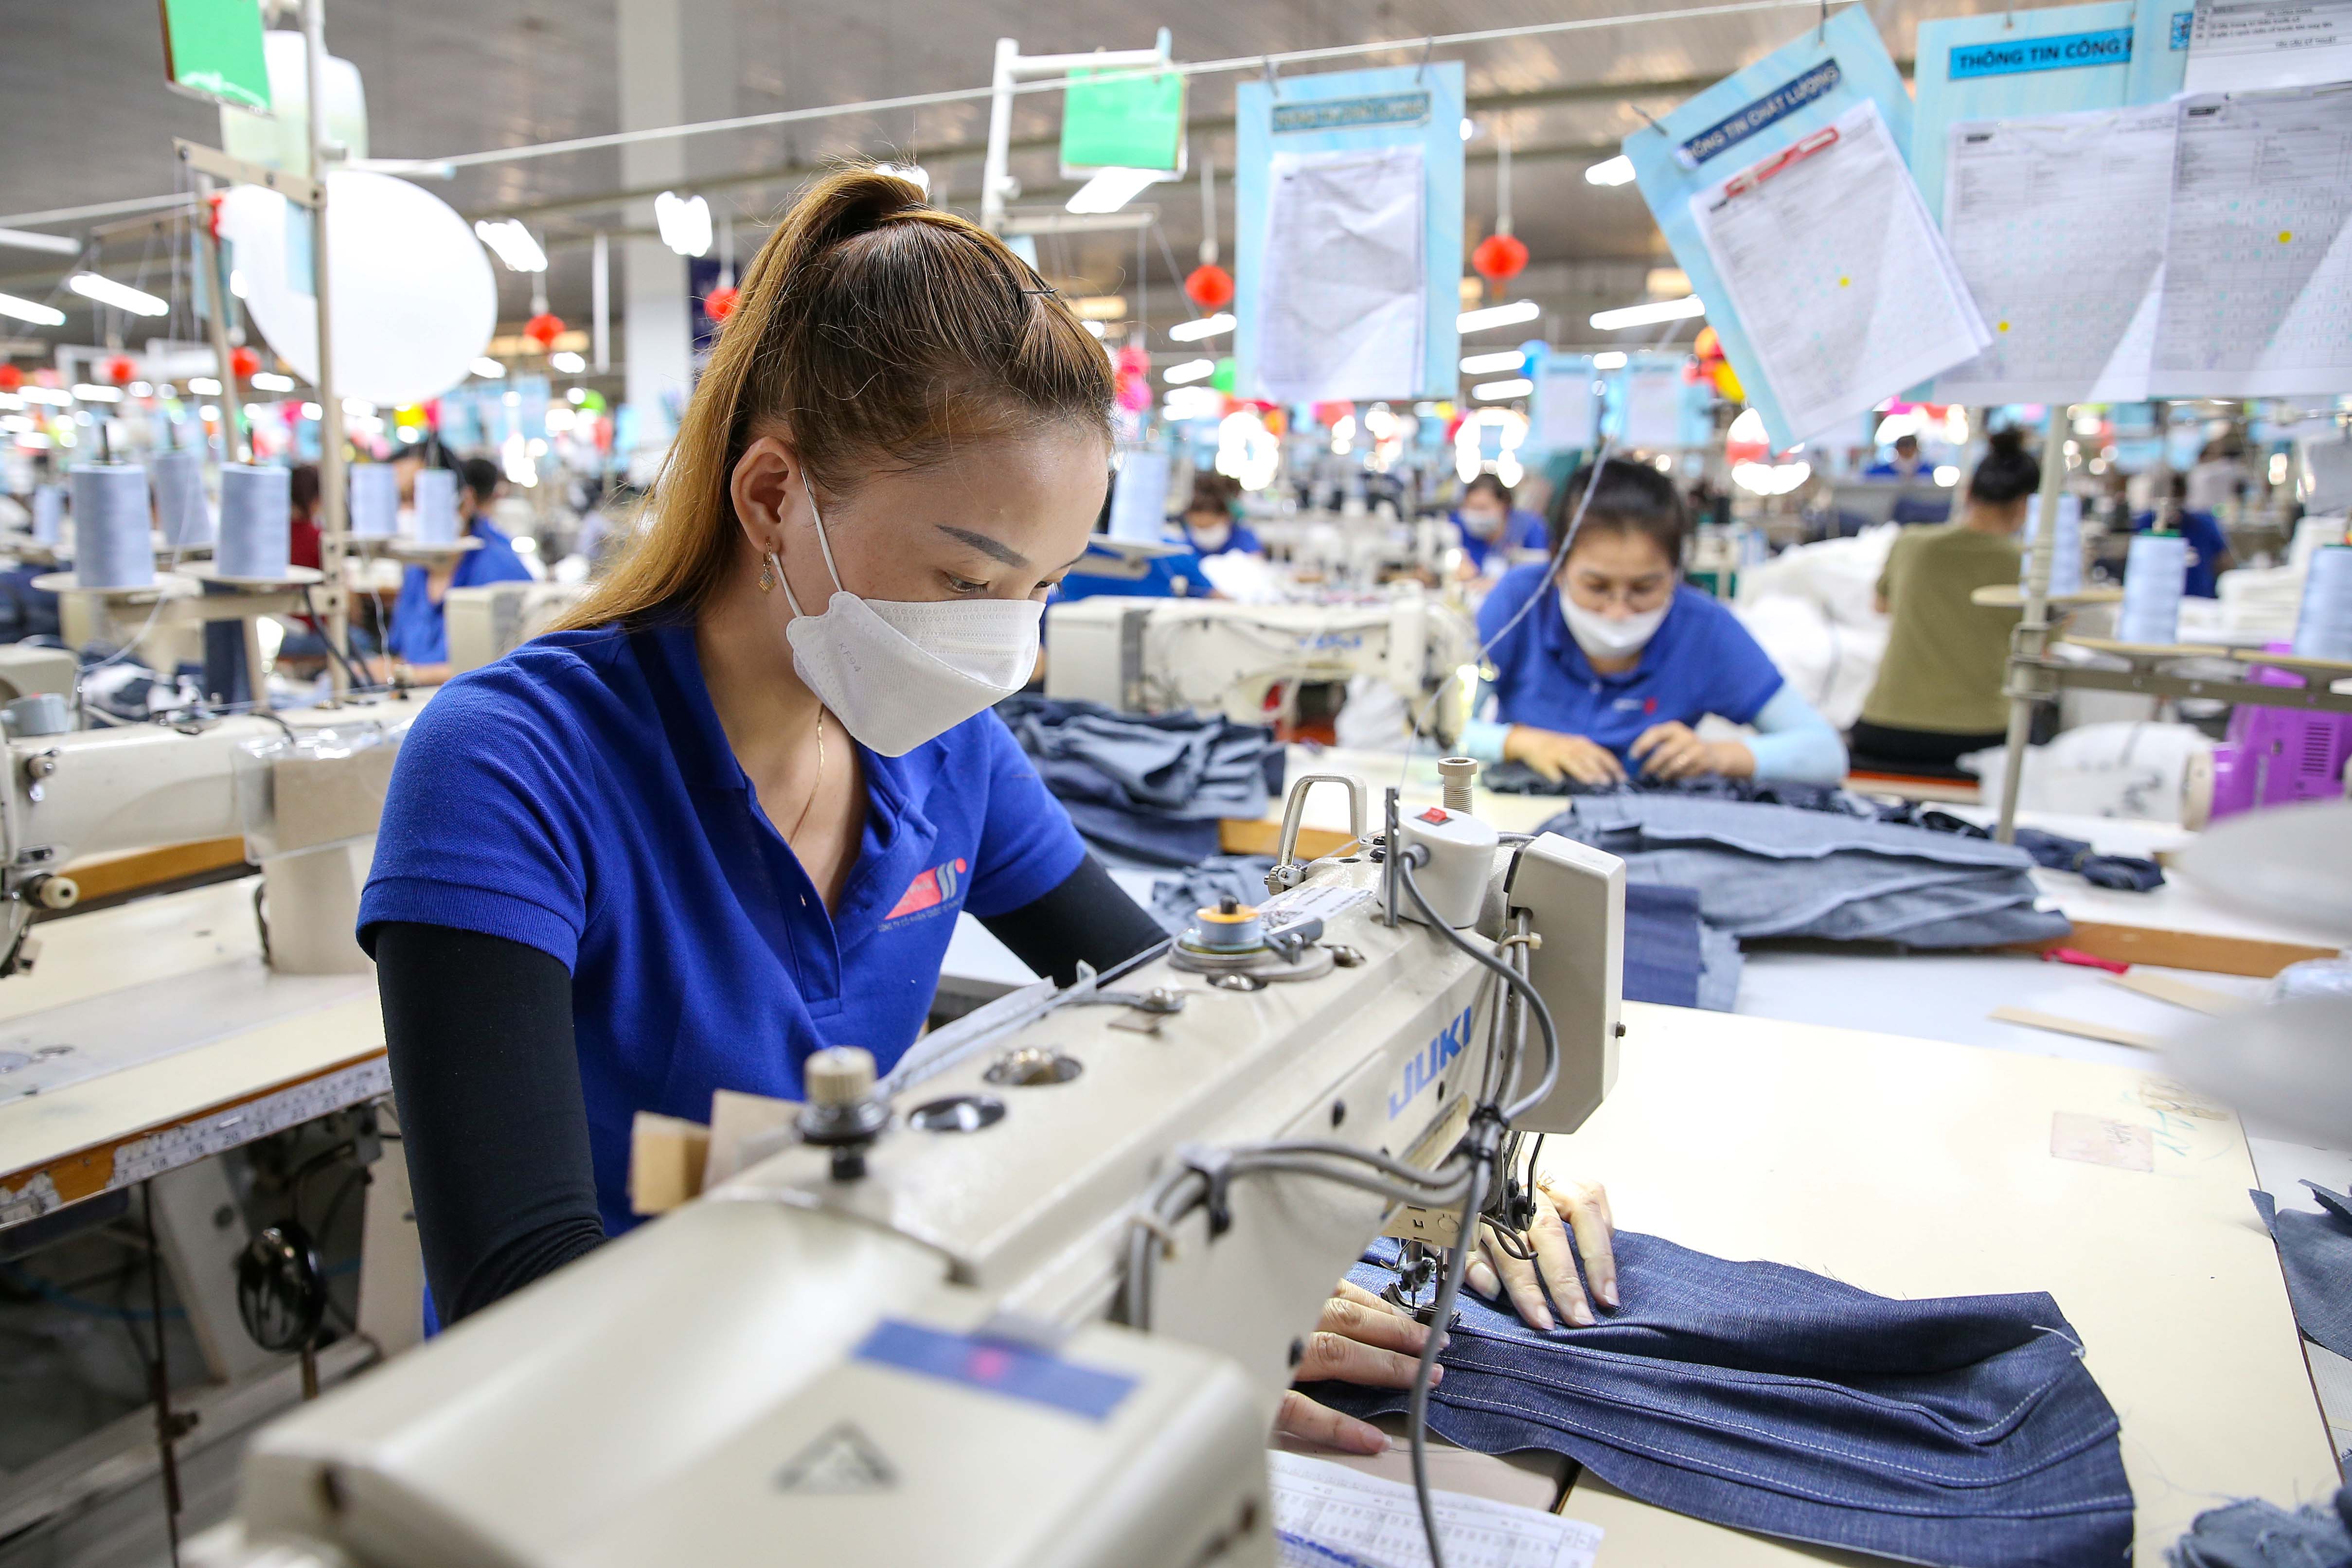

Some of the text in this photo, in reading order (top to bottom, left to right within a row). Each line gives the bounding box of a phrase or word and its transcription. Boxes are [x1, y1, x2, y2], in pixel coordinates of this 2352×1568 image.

[1960, 50, 2023, 70] THÔNG
[2030, 46, 2060, 63] TIN
[2065, 38, 2120, 59] CÔNG
[1682, 129, 1725, 161] ÔNG
[1724, 117, 1749, 139] TIN
[837, 642, 862, 672] KF94
[1389, 1005, 1472, 1121] JUKI
